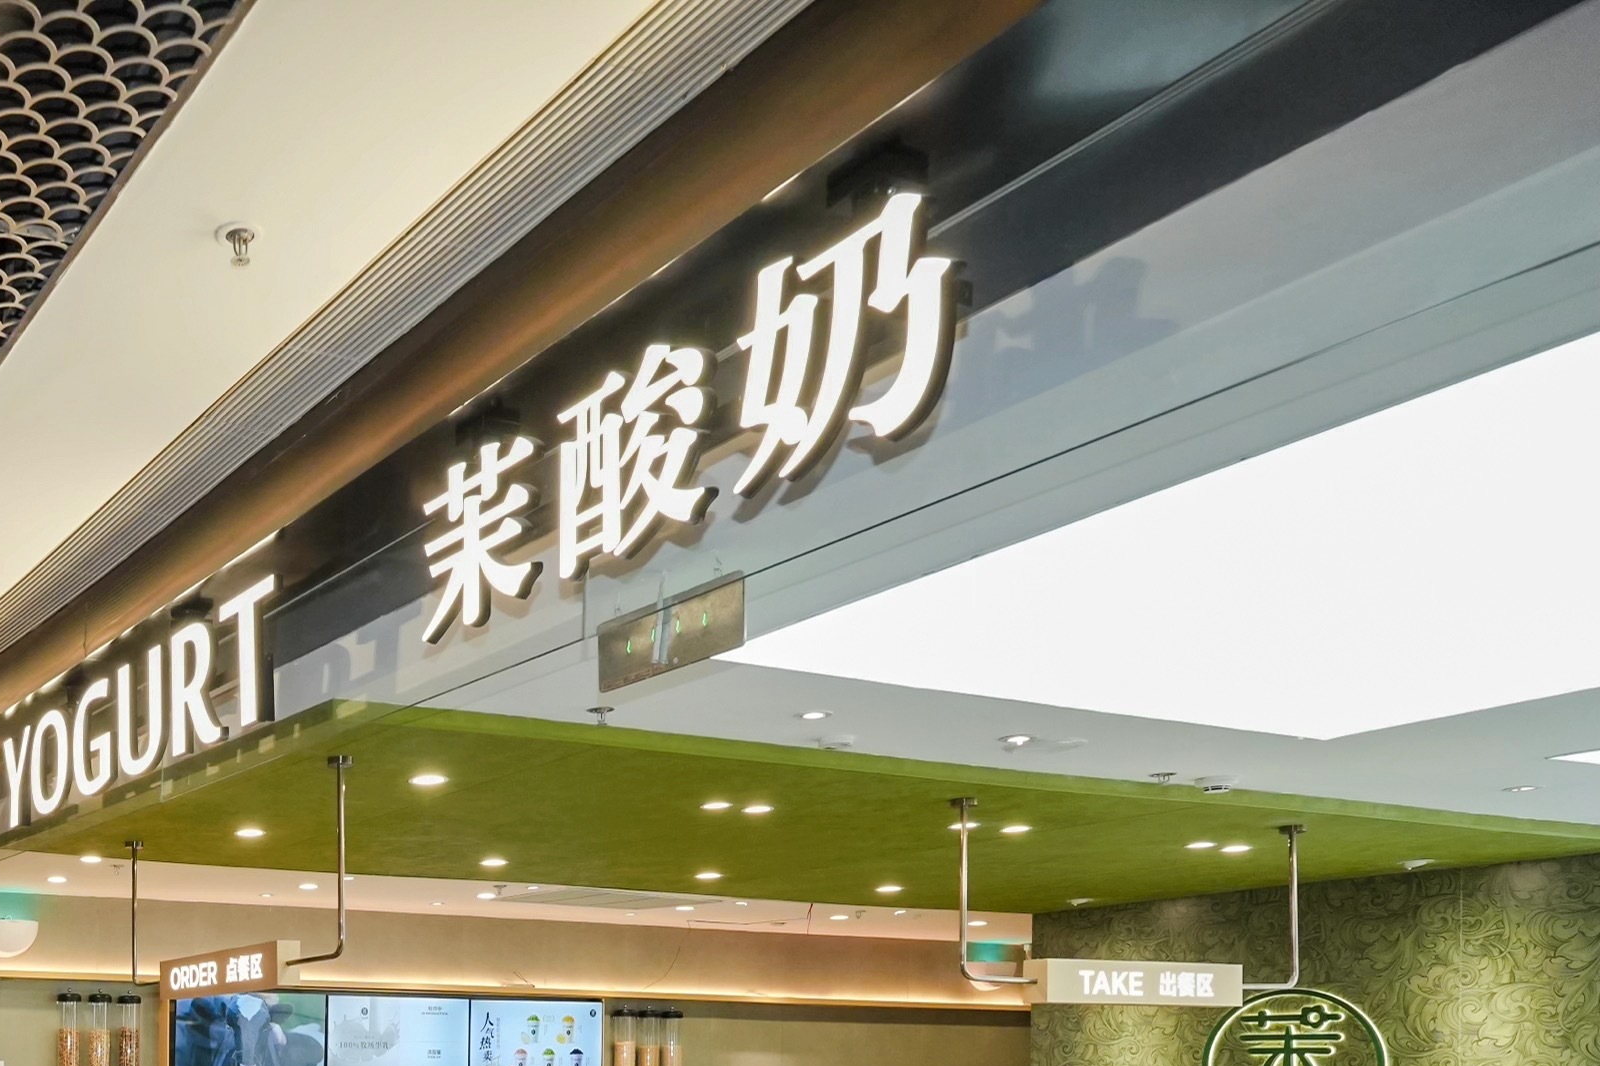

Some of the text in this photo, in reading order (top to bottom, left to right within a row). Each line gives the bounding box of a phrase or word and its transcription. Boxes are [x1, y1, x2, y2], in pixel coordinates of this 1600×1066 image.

[422, 193, 953, 644] 茉酸奶
[3, 573, 279, 829] YOGURT
[169, 953, 263, 990] ORDER 点餐区
[1078, 970, 1215, 997] TAKE 出餐区
